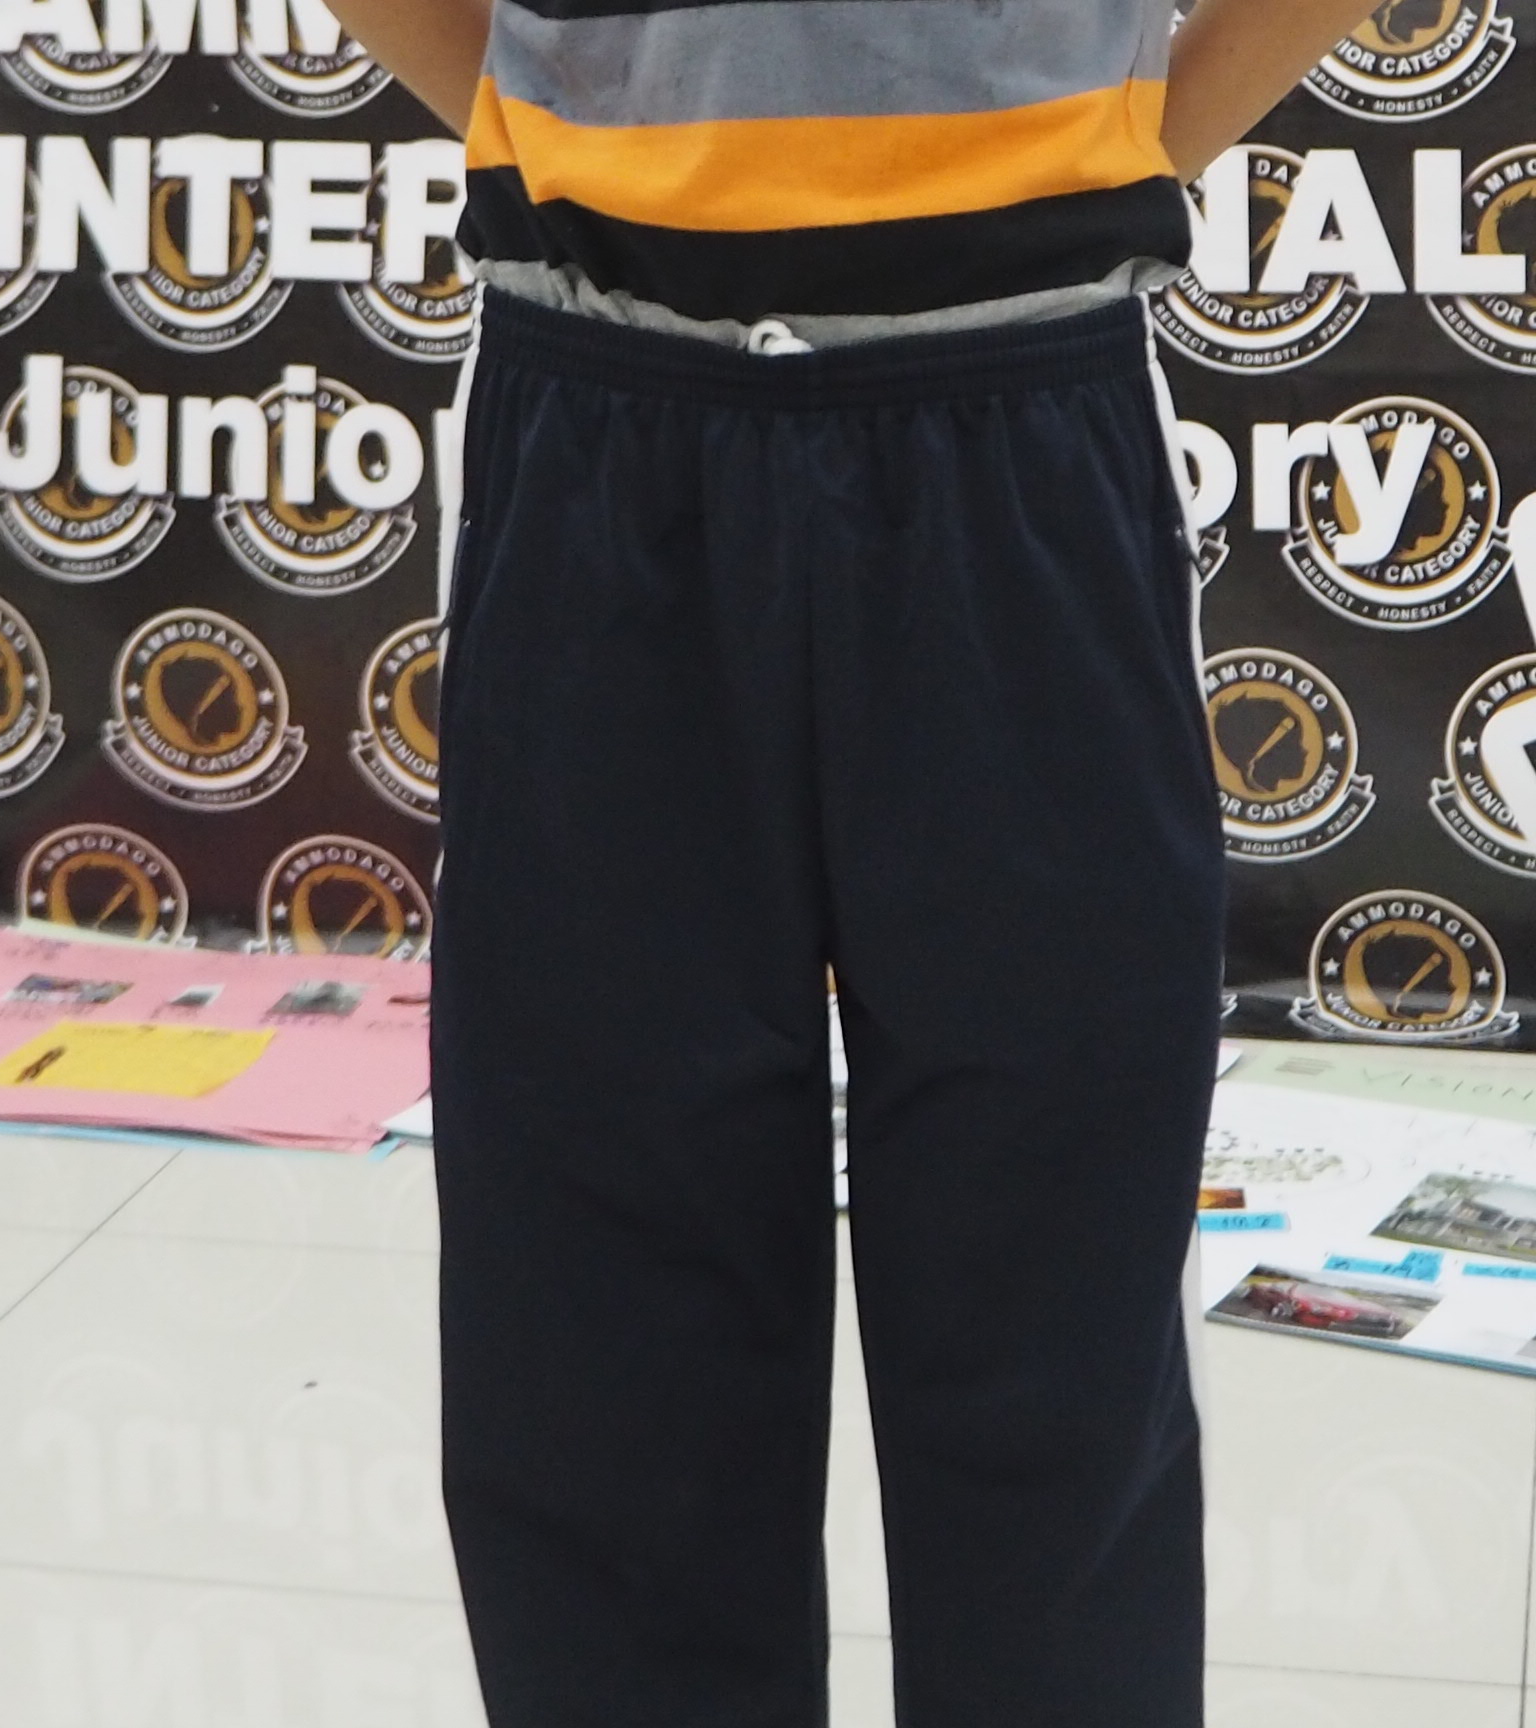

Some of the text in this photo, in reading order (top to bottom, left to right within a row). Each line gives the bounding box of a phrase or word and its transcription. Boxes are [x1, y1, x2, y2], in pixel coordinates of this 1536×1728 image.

[1381, 7, 1478, 75] CATEGORY
[1374, 94, 1443, 112] HONESTY
[1230, 345, 1300, 365] HONESTY
[1385, 515, 1481, 582] CATEGORY
[1301, 558, 1356, 608] RESPECT
[1380, 601, 1448, 620] HONESTY
[1247, 761, 1339, 821] CATEGORY
[1338, 901, 1477, 949] AMMODAGO
